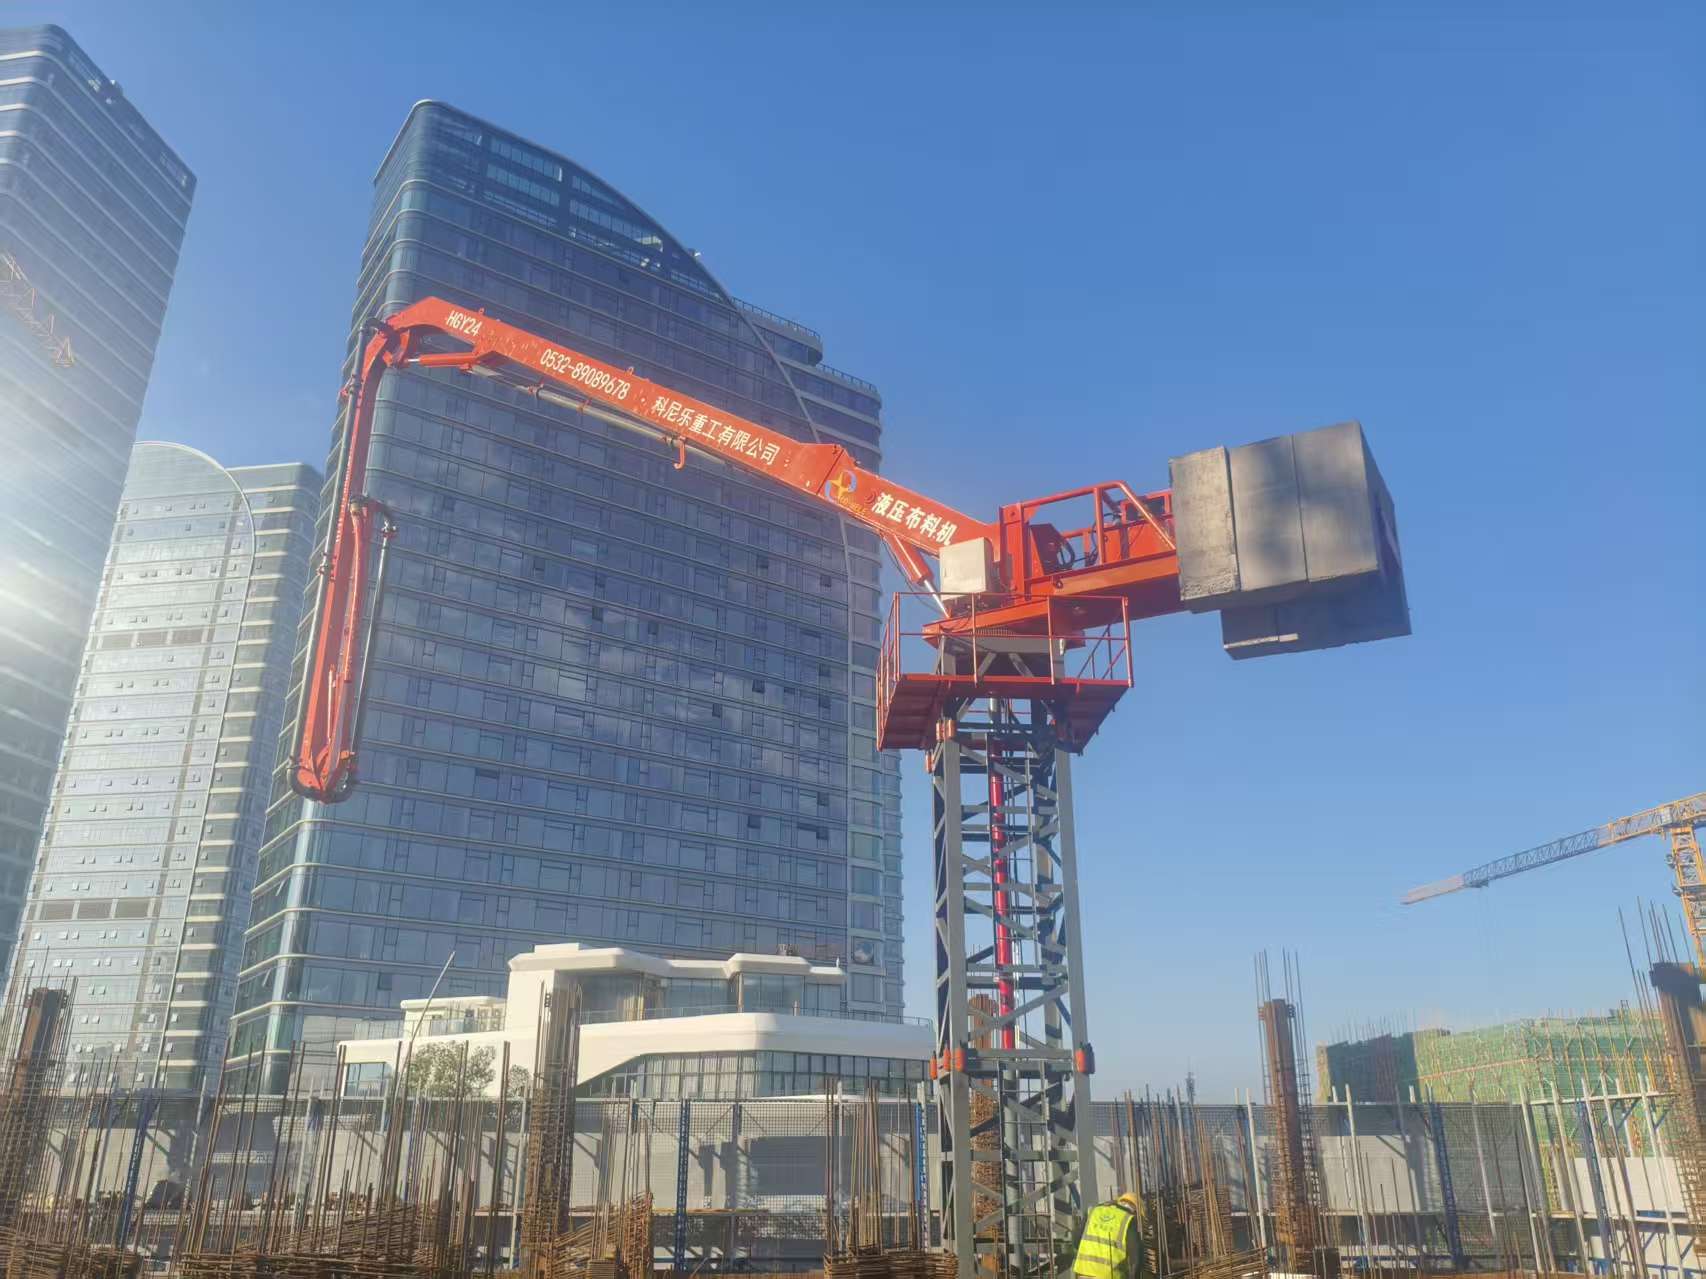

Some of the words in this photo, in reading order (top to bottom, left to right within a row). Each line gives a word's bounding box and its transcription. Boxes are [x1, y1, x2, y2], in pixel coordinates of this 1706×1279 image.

[446, 310, 483, 337] HGY24
[540, 348, 631, 400] 0532-89089678
[651, 396, 780, 465] 科尼乐重工有限公司
[871, 492, 957, 546] 液压布料机
